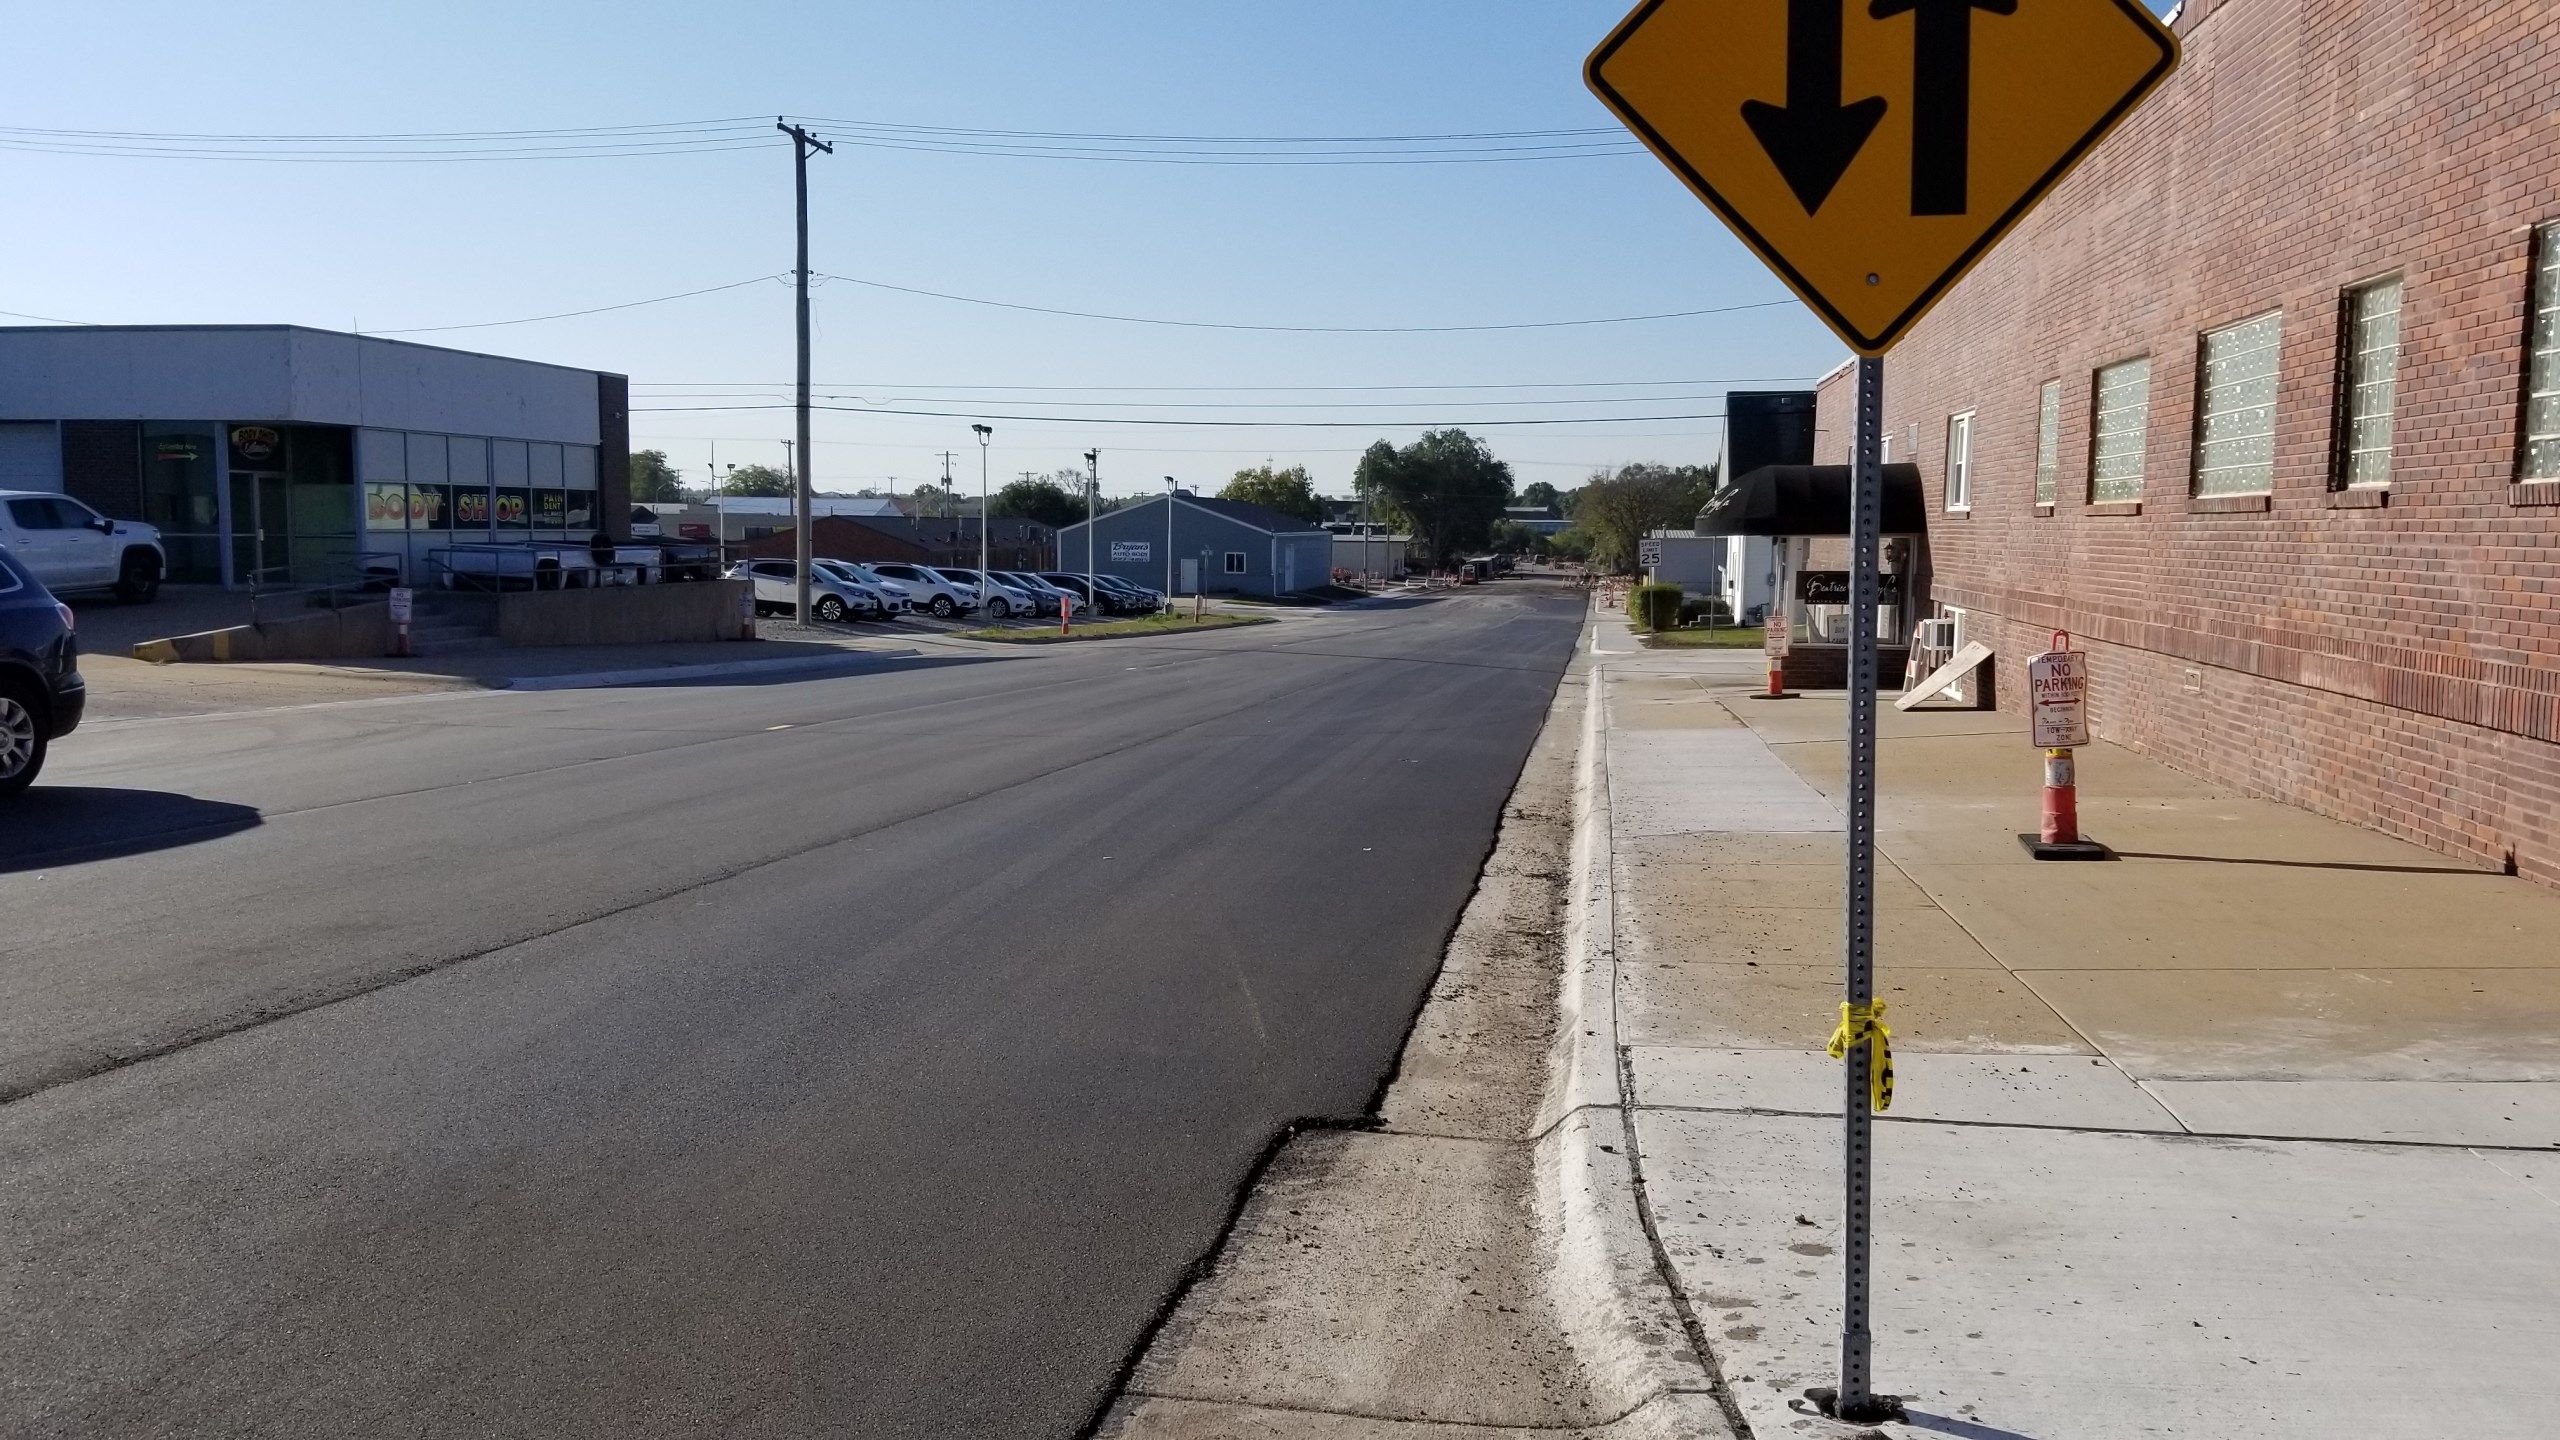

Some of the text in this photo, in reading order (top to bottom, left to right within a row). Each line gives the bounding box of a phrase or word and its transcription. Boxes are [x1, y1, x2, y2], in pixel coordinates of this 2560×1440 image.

[368, 493, 524, 522] BODY SHOP
[1641, 553, 1660, 565] 25
[1806, 574, 1847, 598] Beatrice
[2037, 655, 2079, 664] TEMPORARY
[2051, 663, 2071, 677] NO
[2035, 676, 2084, 692] PARKING
